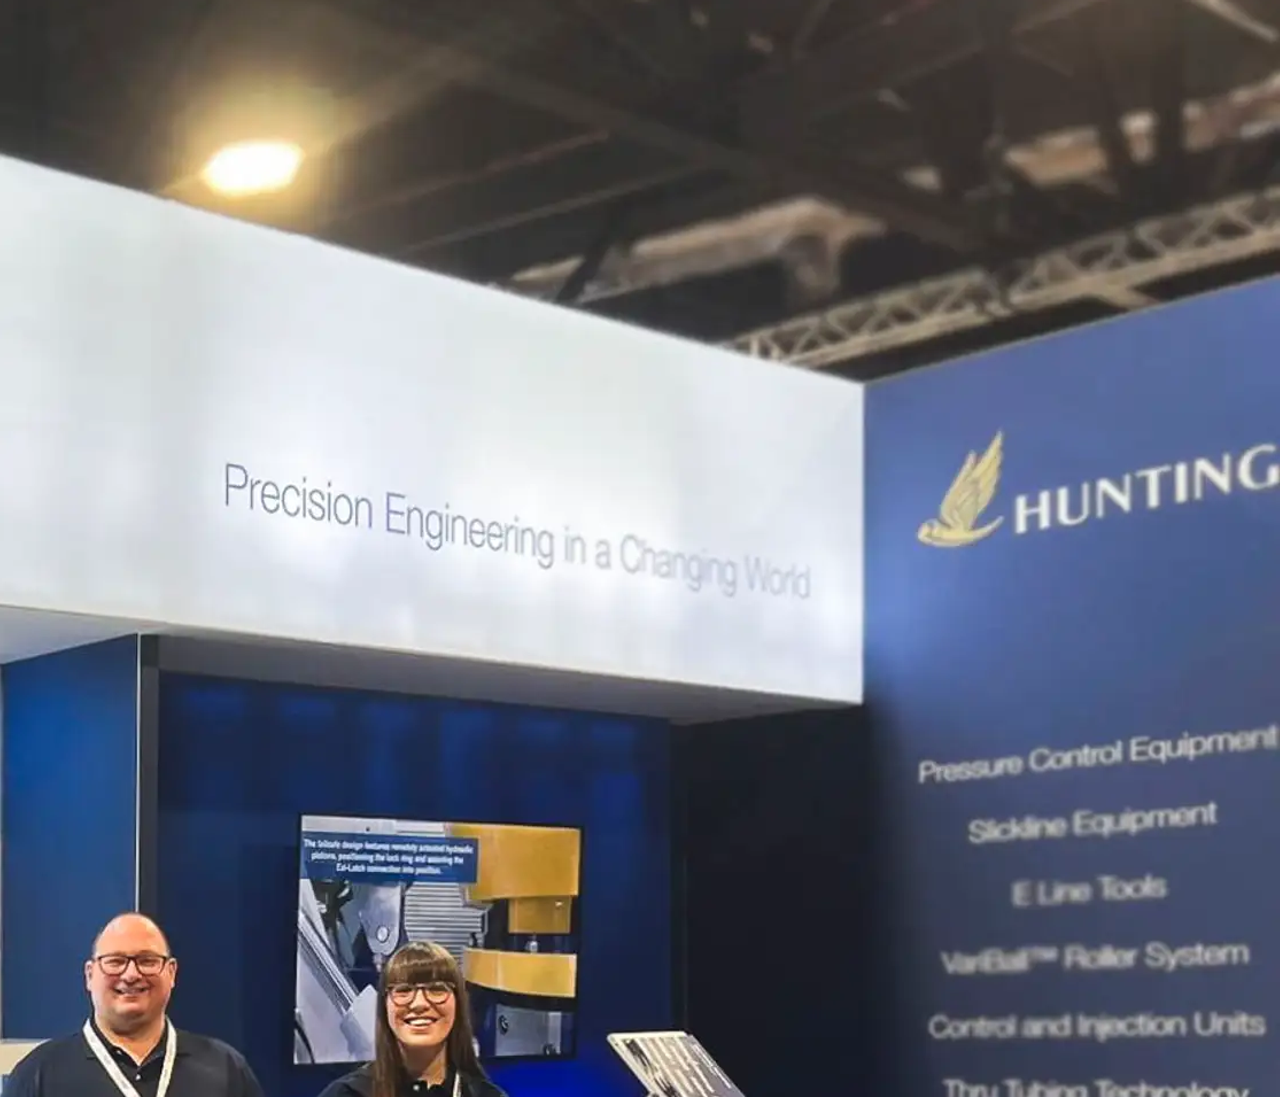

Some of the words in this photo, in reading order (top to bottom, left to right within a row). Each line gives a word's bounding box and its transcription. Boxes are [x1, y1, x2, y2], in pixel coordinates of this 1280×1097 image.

[1015, 444, 1280, 534] HUNTING
[224, 463, 373, 529] Precision
[385, 492, 554, 569] Engineering
[563, 526, 586, 564] in
[595, 541, 611, 568] a
[620, 533, 737, 597] Changing
[744, 554, 812, 600] World
[919, 755, 1023, 784] Pressure
[1030, 739, 1123, 773] Control
[1131, 724, 1278, 763] Equipment
[969, 815, 1067, 843] Slickline
[1073, 801, 1218, 838] Equipment
[1011, 881, 1030, 908] E
[1038, 880, 1092, 905] Line
[1097, 874, 1169, 900] Tools
[1064, 944, 1138, 970] Roller
[1144, 942, 1250, 973] System
[928, 1013, 1016, 1040] Control
[1023, 1013, 1072, 1039] and
[1078, 1012, 1186, 1042] Injection
[1194, 1011, 1267, 1037] Units
